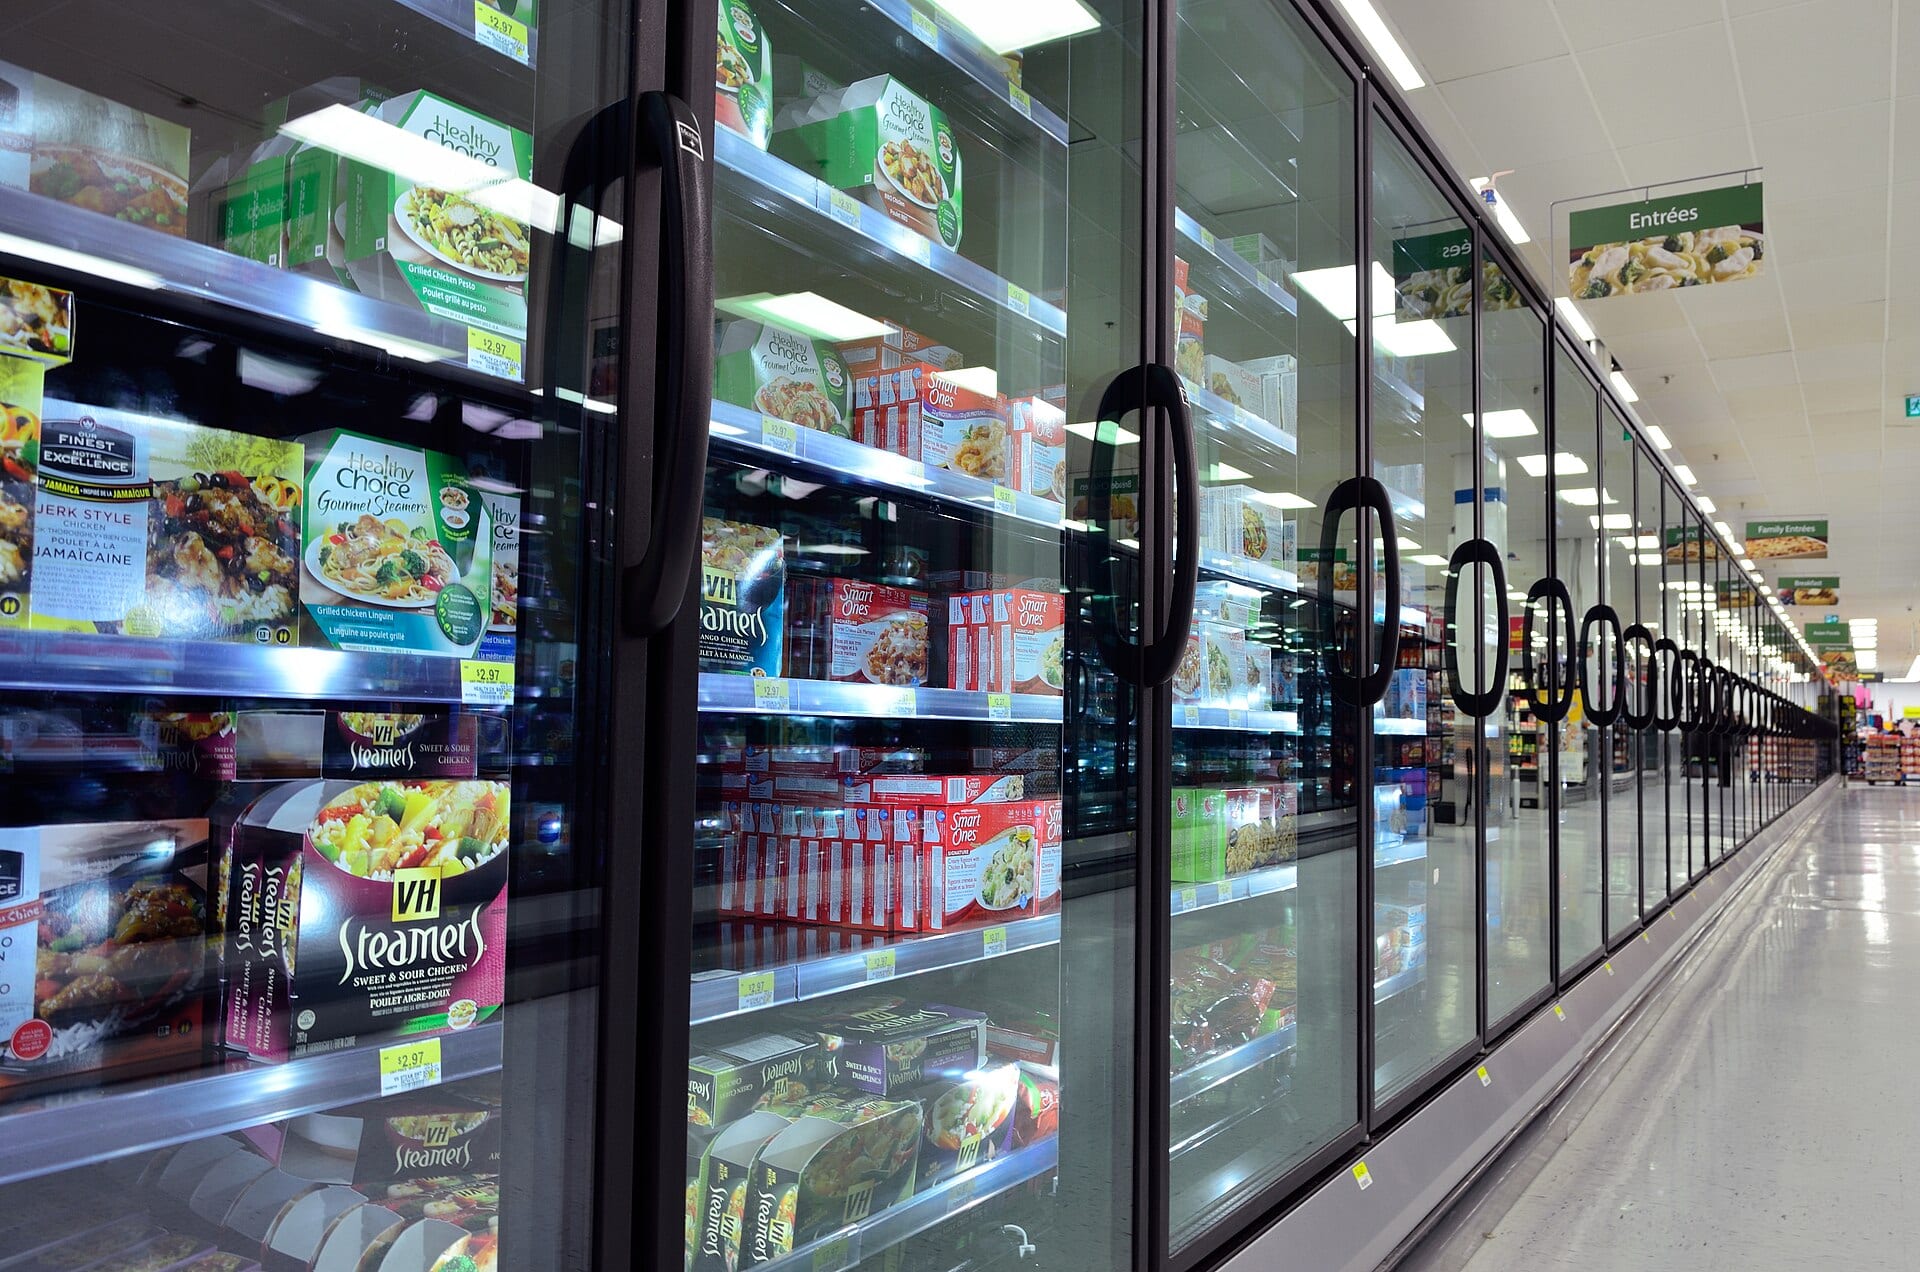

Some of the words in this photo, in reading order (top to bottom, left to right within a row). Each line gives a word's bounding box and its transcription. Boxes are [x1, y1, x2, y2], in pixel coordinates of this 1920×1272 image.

[490, 15, 513, 36] $2.97
[891, 102, 924, 133] Choice
[895, 92, 925, 123] Healthy
[883, 114, 907, 136] Gourmet
[433, 115, 500, 157] Healthy
[1630, 207, 1698, 230] Entrées
[408, 263, 431, 277] Grilled
[432, 269, 458, 285] Chicken
[458, 278, 476, 291] Pesto
[422, 286, 444, 299] Poulet
[461, 299, 470, 308] au
[470, 302, 487, 314] pesto
[483, 338, 506, 355] $2.97
[773, 331, 807, 354] Healthy
[904, 331, 920, 345] Smart
[904, 341, 917, 350] Ones
[761, 354, 789, 373] Gourmet
[769, 341, 808, 365] Choice
[929, 388, 955, 408] Ones
[78, 431, 98, 440] OUR
[1036, 422, 1053, 439] Ones
[58, 433, 116, 452] FINEST
[43, 449, 130, 473] EXCELLENCE
[72, 450, 103, 460] NOTRE
[347, 451, 414, 483] Healthy
[45, 479, 80, 495] JAMAICA
[112, 487, 151, 499] JAMAÏQUE
[336, 467, 412, 500] Choice
[317, 489, 371, 516] Gourmet
[373, 495, 427, 517] Steamers
[36, 503, 77, 518] JERK
[83, 508, 132, 525] STYLE
[63, 519, 106, 531] CHICKEN
[1757, 525, 1784, 535] Family
[1784, 525, 1817, 533] Entrées
[51, 536, 90, 549] POULET
[94, 540, 101, 549] À
[103, 542, 116, 550] LA
[33, 546, 132, 566] JAMAÏCAINE
[706, 574, 733, 600] VH
[840, 584, 874, 602] Smart
[1794, 579, 1823, 587] Breakfast
[842, 601, 869, 616] Ones
[1018, 594, 1048, 612] Smart
[317, 606, 340, 616] Grilled
[340, 608, 368, 619] Chicken
[368, 610, 394, 622] Linguini
[1019, 610, 1044, 627] Ones
[329, 627, 359, 638] Linguine
[359, 630, 369, 638] au
[369, 630, 389, 640] poulet
[700, 605, 766, 646] amers
[700, 633, 719, 642] ANGO
[720, 635, 748, 646] CHICKEN
[728, 653, 754, 662] MANGUE
[476, 669, 500, 681] $2.97
[374, 725, 393, 742] VH
[419, 743, 443, 752] SWEET
[450, 744, 470, 752] SOUR
[438, 755, 470, 765] CHICKEN
[966, 778, 981, 790] Smart
[966, 789, 979, 799] Ones
[950, 811, 981, 831] Smart
[952, 828, 978, 846] Ones
[236, 862, 259, 951] Steamers
[398, 878, 437, 914] VH
[258, 866, 284, 958] Steamers
[279, 902, 291, 930] VH
[338, 903, 484, 985] Steamers
[243, 960, 252, 998] SWEET
[353, 974, 387, 987] SWEET
[388, 972, 396, 983] &
[399, 970, 425, 981] SOUR
[427, 963, 468, 977] CHICKEN
[266, 967, 276, 1007] SWEET
[370, 996, 402, 1009] POULET
[402, 988, 451, 1004] AIGRE-DOUX
[232, 988, 242, 1039] CHICKEN
[255, 996, 265, 1050] CHICKEN
[240, 1009, 248, 1041] SOUR
[262, 1018, 272, 1051] SOUR
[397, 1051, 425, 1067] $2.97
[845, 1060, 863, 1071] SWEET
[867, 1065, 882, 1075] SPICY
[761, 1052, 803, 1089] Steamers
[852, 1071, 882, 1084] DUMPLINGS
[888, 1065, 923, 1089] Steamers
[775, 1079, 788, 1096] VH
[427, 1126, 449, 1143] VH
[394, 1138, 472, 1176] Steamers
[959, 1142, 976, 1169] VH
[846, 1187, 873, 1219] VH
[702, 1184, 729, 1258] Steamers
[723, 1216, 734, 1238] VH
[751, 1190, 777, 1262] Steamers
[771, 1221, 785, 1243] VH
